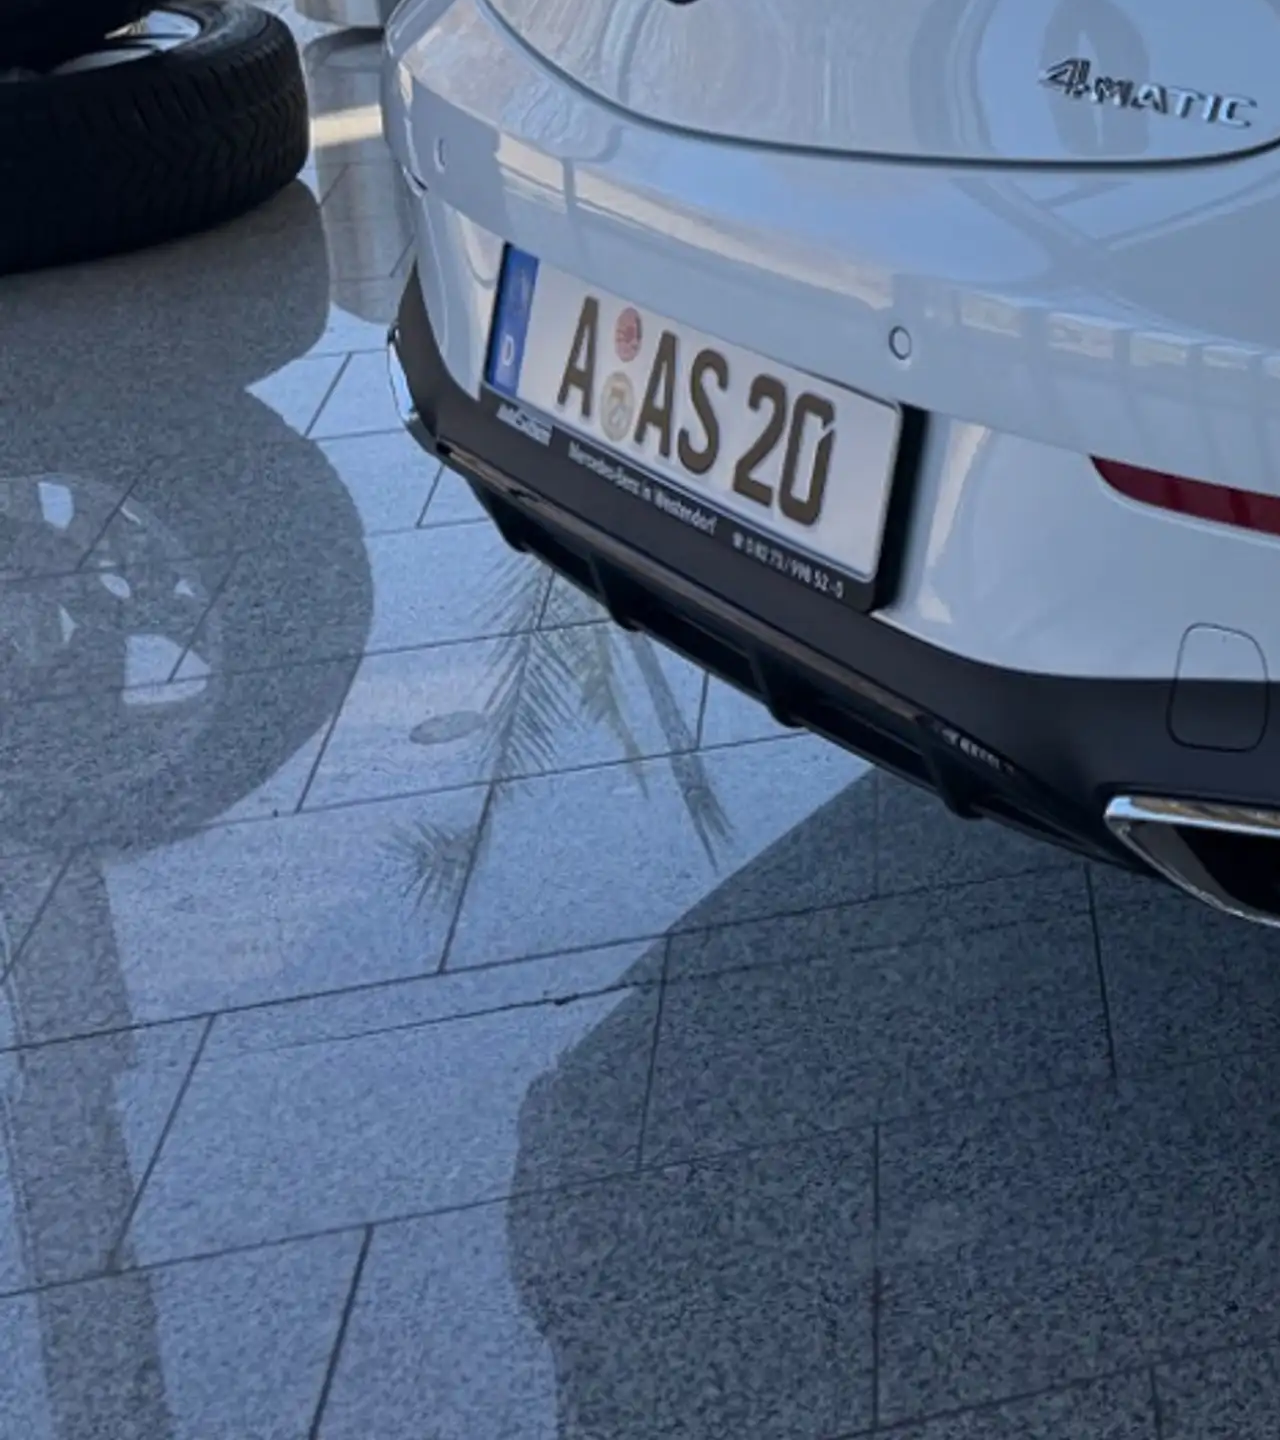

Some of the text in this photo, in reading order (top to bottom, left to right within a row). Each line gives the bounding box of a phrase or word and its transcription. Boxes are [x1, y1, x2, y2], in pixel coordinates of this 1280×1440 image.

[1043, 57, 1258, 128] 4MATIC
[501, 334, 514, 367] D
[556, 295, 600, 419] A
[633, 329, 730, 475] AS
[731, 373, 837, 527] 20
[567, 440, 641, 496] Mercedes-Benz
